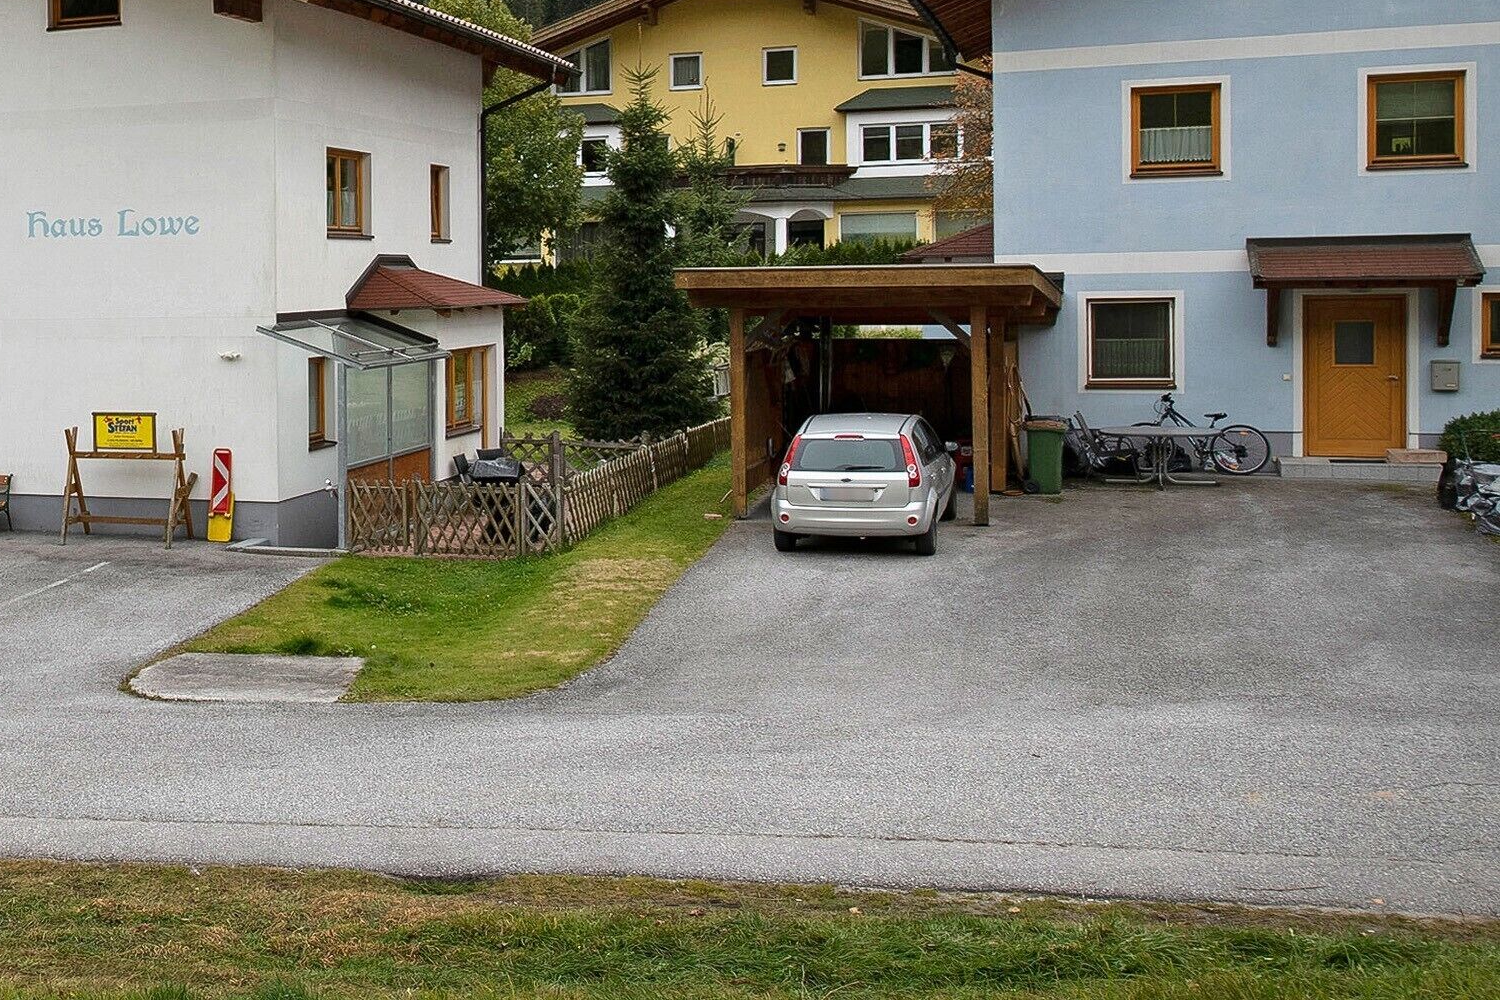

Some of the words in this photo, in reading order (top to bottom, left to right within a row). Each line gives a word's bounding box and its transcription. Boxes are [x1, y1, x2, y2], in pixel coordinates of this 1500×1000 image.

[26, 210, 103, 238] Haus
[117, 208, 200, 237] Lowe
[114, 417, 135, 426] Sport
[107, 422, 138, 434] STEFAN
